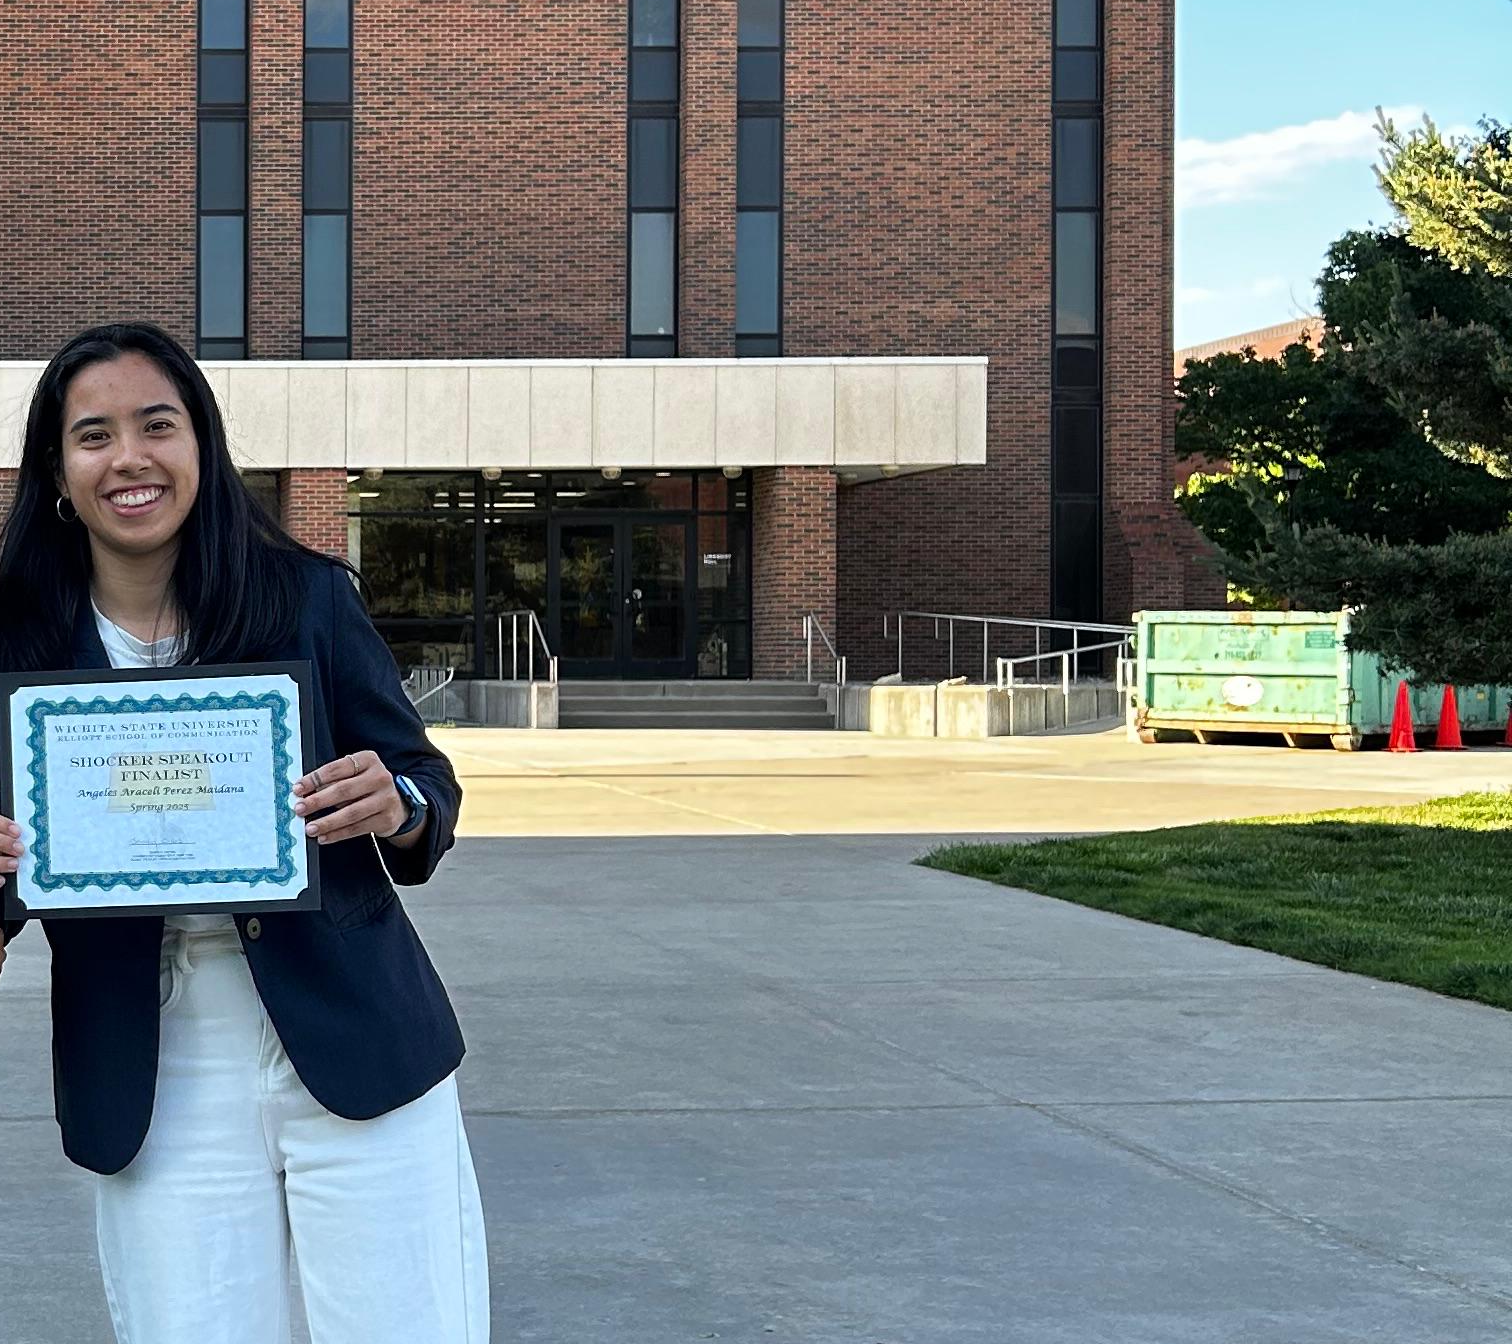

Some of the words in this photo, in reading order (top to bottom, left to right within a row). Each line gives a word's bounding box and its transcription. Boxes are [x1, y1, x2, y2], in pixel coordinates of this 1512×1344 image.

[54, 724, 116, 733] WICHITA
[121, 723, 166, 731] STATE
[171, 719, 260, 729] UNIVERSITY
[168, 729, 258, 738] COMMUNICATION
[70, 755, 153, 768] SHOCKER
[158, 752, 252, 765] SPEAKOUT
[120, 768, 203, 781] FINALIST
[76, 787, 118, 800] Angeles
[162, 786, 193, 795] Perez
[195, 784, 245, 794] Maidana
[129, 802, 164, 814] Spring
